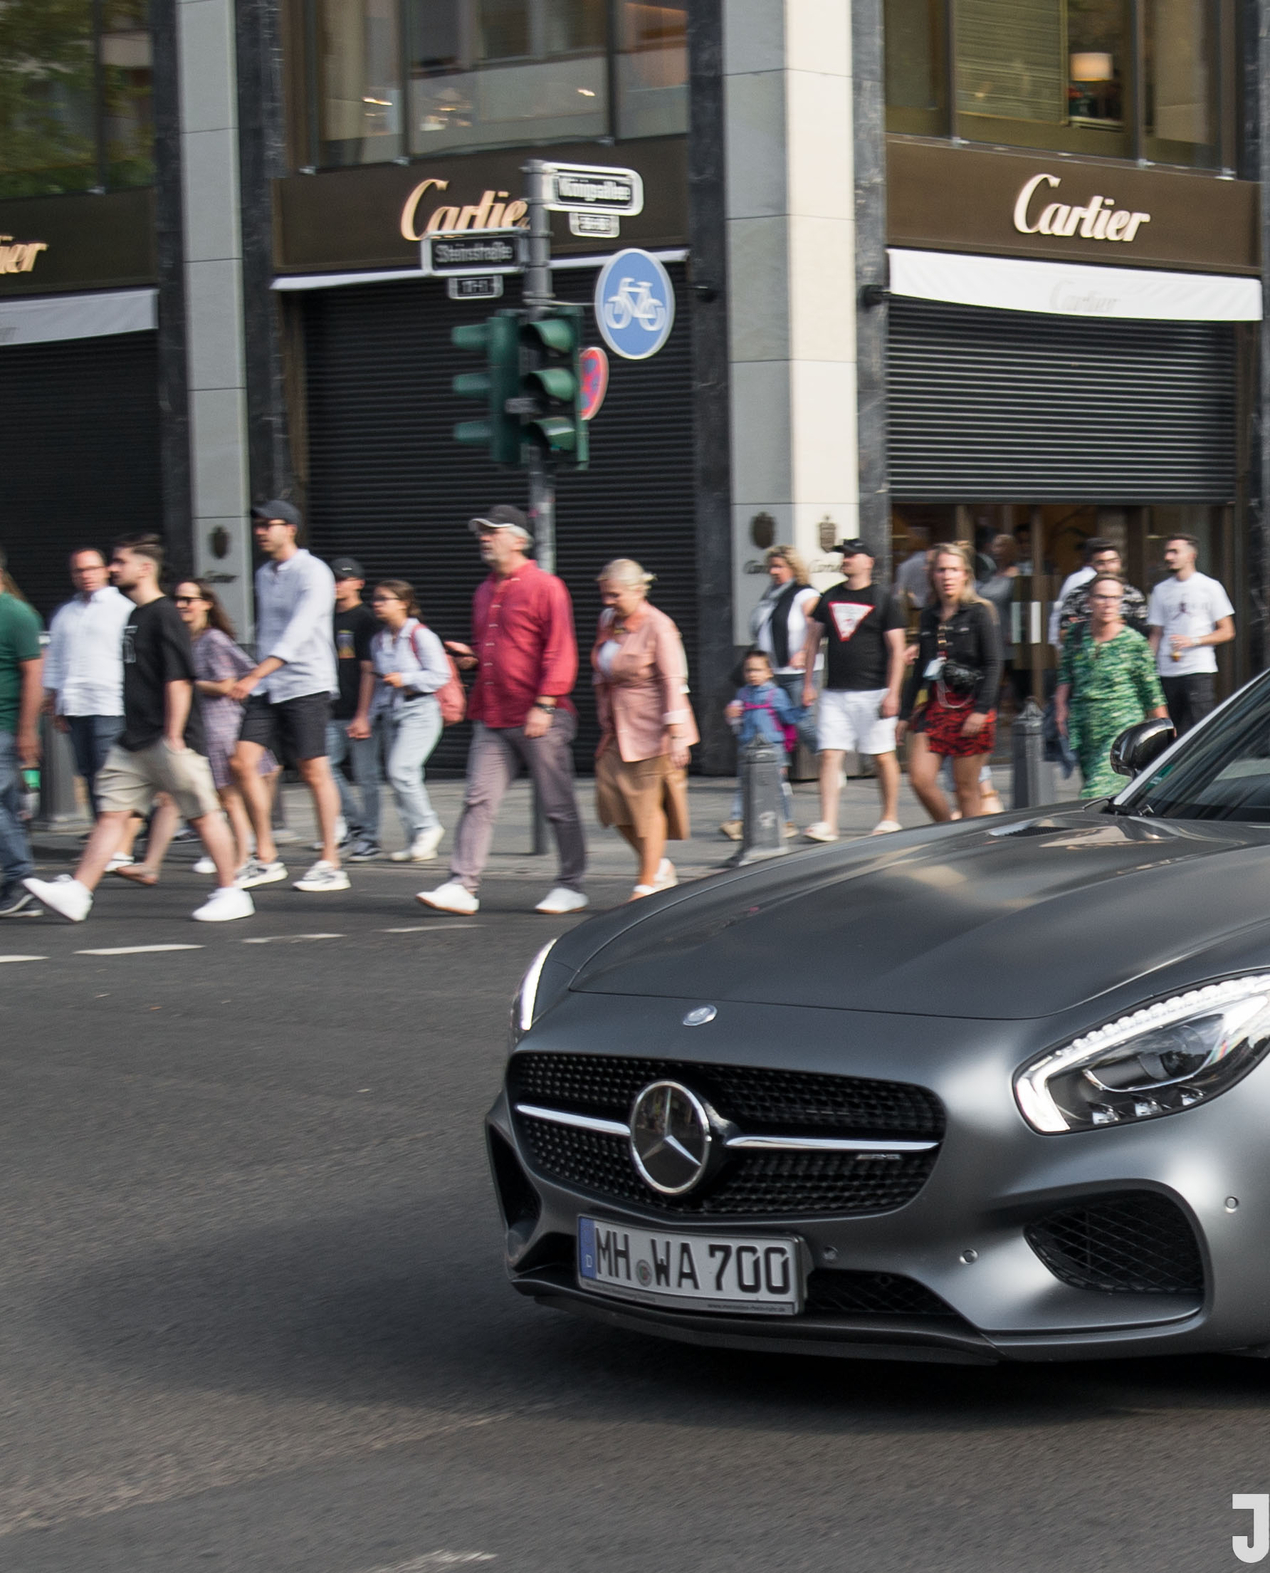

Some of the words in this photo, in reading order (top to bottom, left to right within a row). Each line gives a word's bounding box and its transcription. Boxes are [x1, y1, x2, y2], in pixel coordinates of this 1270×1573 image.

[401, 178, 530, 241] Cartie
[1013, 173, 1151, 242] Cartier
[596, 1227, 632, 1281] MH
[651, 1239, 700, 1290] WA
[708, 1243, 791, 1295] 700
